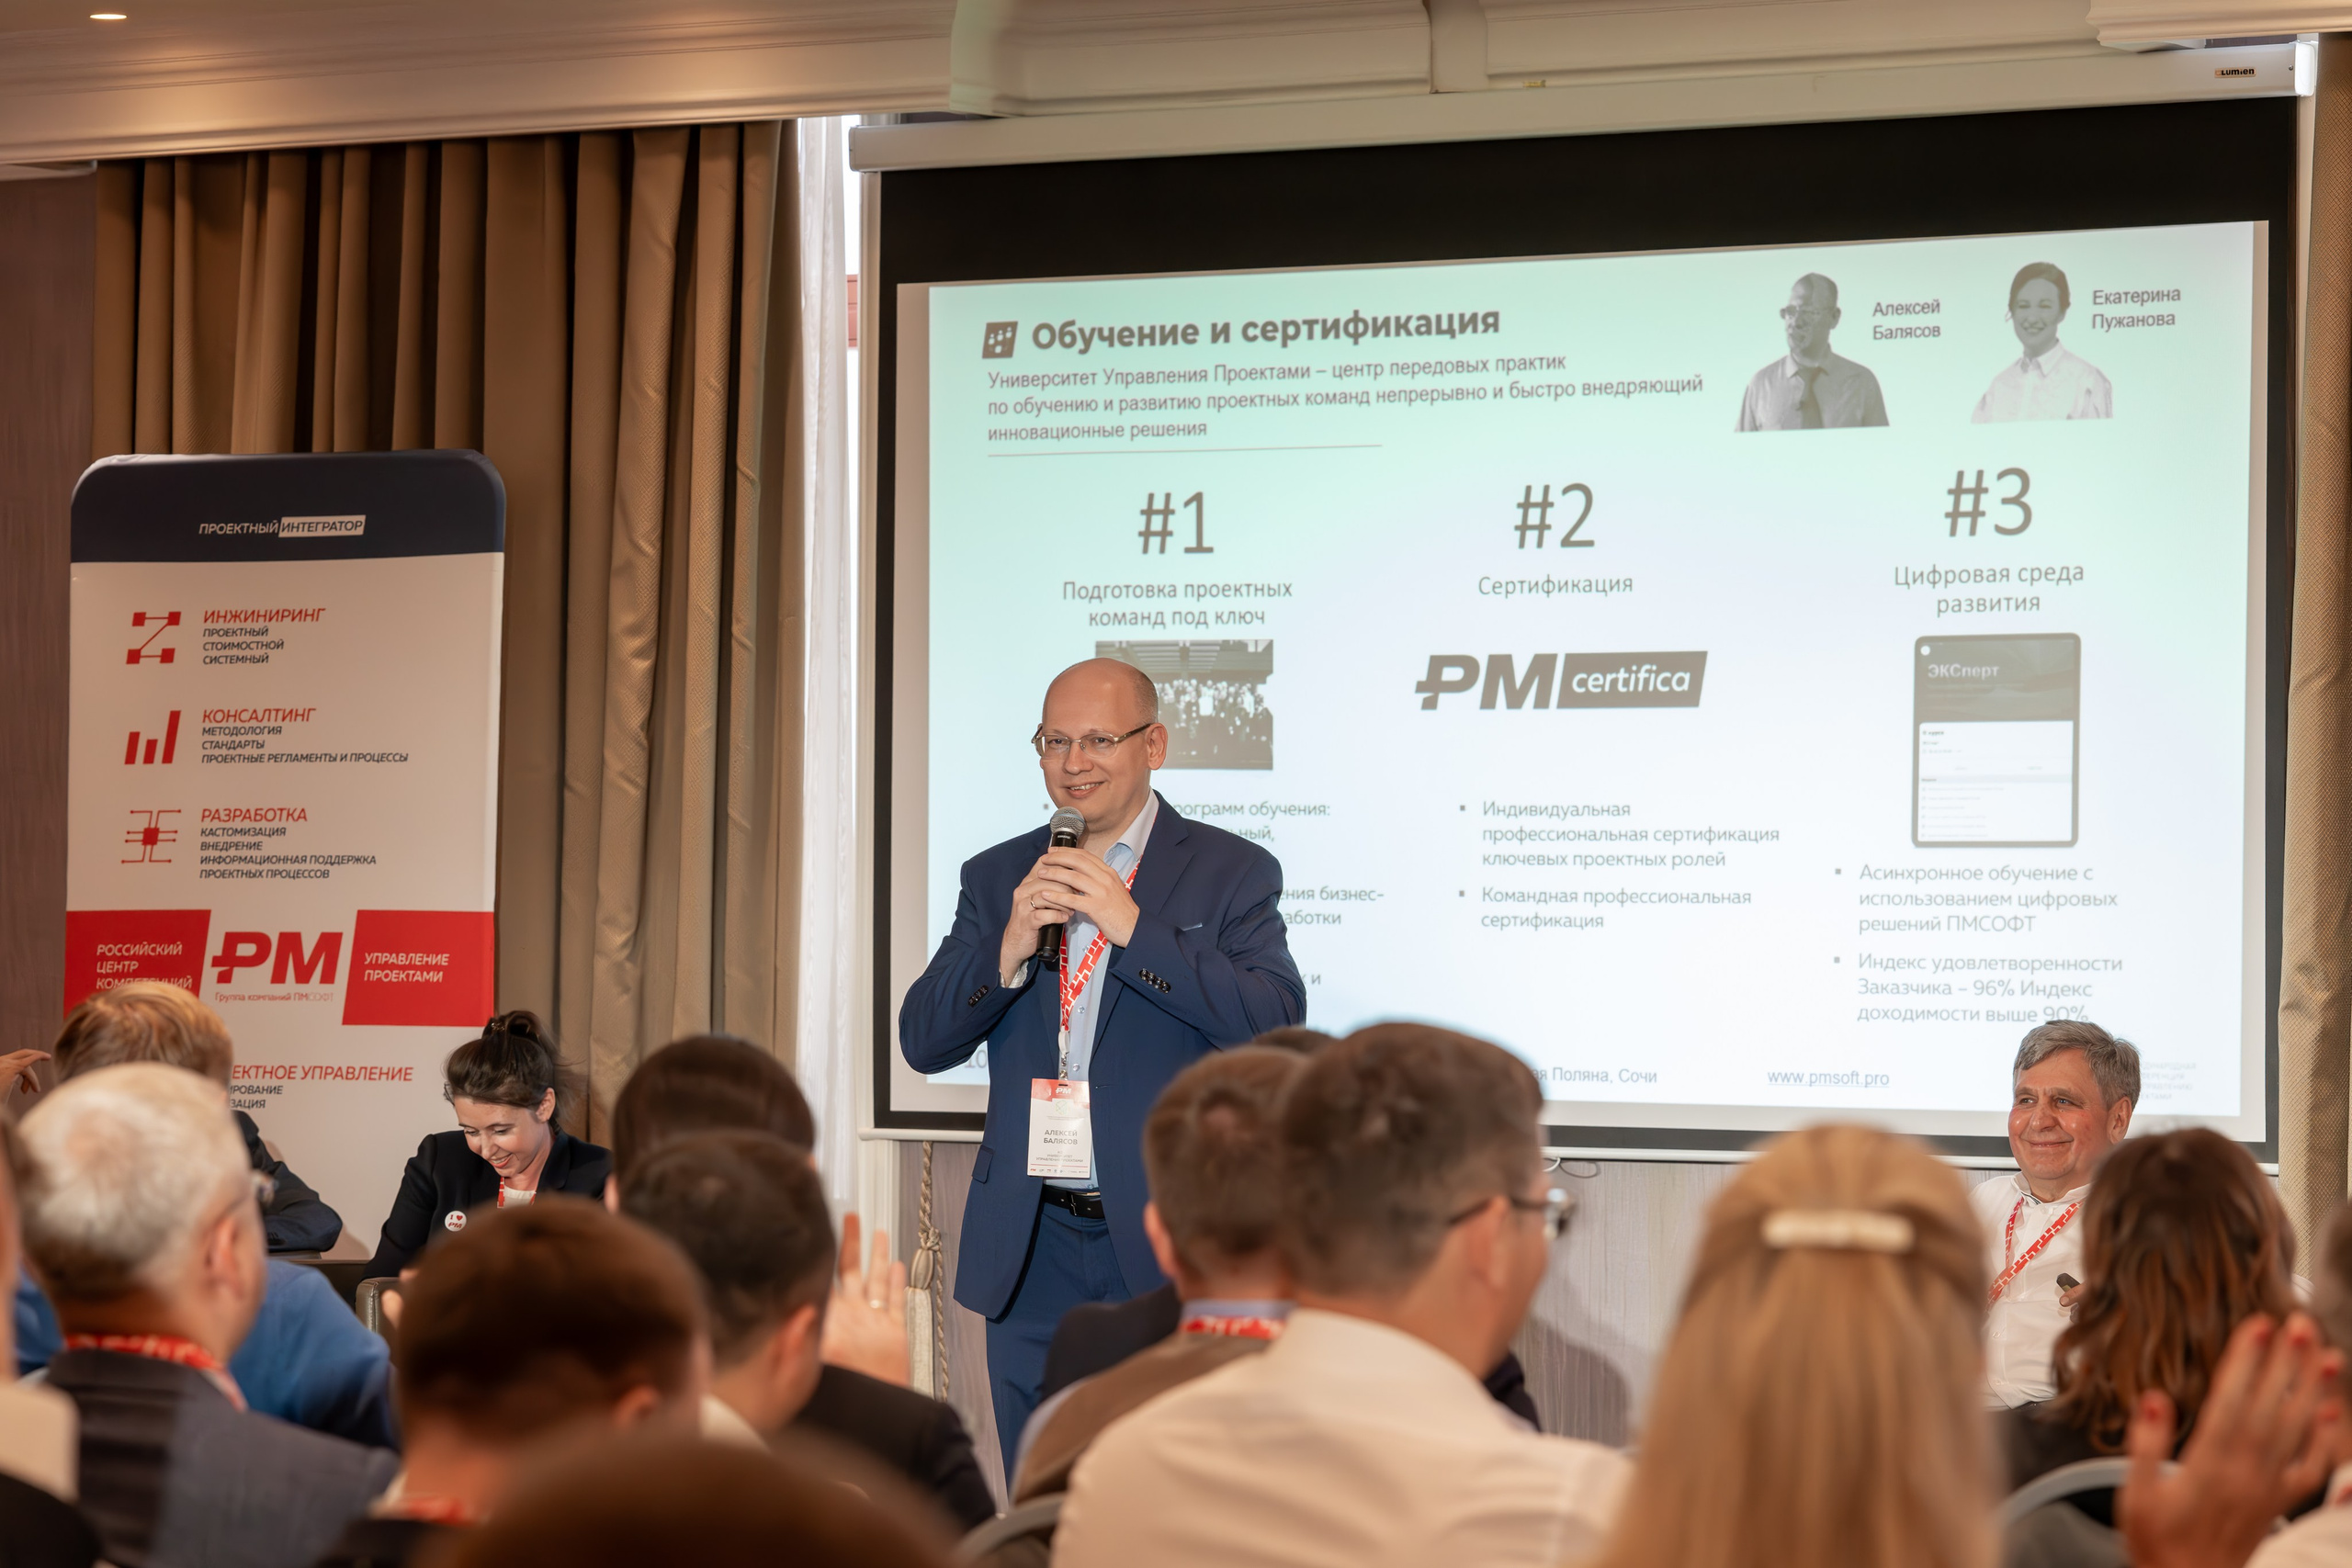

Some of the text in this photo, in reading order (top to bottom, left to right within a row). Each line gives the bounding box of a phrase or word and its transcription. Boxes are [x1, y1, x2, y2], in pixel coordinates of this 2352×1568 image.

[2092, 286, 2181, 307] Екатерина
[1872, 299, 1940, 318] Алексей
[2091, 310, 2176, 333] Пужанова
[1032, 310, 1499, 355] Обучение и сертификация
[1872, 321, 1941, 342] Балясов
[988, 369, 1098, 391] Университет
[1102, 367, 1208, 389] Управления
[1215, 364, 1311, 386] Проектами
[1332, 359, 1385, 379] центр
[1389, 357, 1489, 378] передовых
[1496, 355, 1566, 375] практик
[988, 374, 1703, 418] по обучению и развитию проектных команд непрерывно и быстро внедряющий
[988, 421, 1207, 443] инновационные решения
[1943, 467, 2032, 537] #3
[1137, 491, 1215, 555] #1
[1513, 482, 1596, 551] #2
[198, 520, 363, 535] ПРОЕКТНЫЙ ИНТЕГРАТОР
[1477, 573, 1634, 599] Сертификация
[1893, 563, 2085, 590] Цифровая среда
[1062, 581, 1293, 604] Подготовка проектных
[1936, 593, 2041, 618] развития
[202, 608, 326, 624] ИНЖИНИРИНГ
[1089, 610, 1265, 629] команд под ключ
[202, 626, 269, 637] ПРОЕКТНЫЙ
[202, 639, 285, 651] СТОИМОСТНОЙ
[202, 652, 270, 665] СИСТЕМНЫЙ
[1928, 663, 1999, 680] ЭКСперт
[1415, 653, 1691, 711] PM certifica
[202, 708, 317, 724] КОНСАЛТИНГ
[202, 726, 283, 737] МЕТОДОЛОГИЯ
[201, 739, 266, 751] СТАНДАРТЫ
[200, 752, 410, 764] ПРОЕКТНЫЕ РЕГЛАМЕНТЫ И ПРОЦЕССЫ
[200, 808, 309, 823] РАЗРАБОТКА
[1172, 801, 1330, 820] рограмм обучения:
[1483, 801, 1632, 820] Индивидуальная
[200, 827, 288, 840] КАСТОМИЗАЦИЯ
[1483, 826, 1780, 845] профессиональная сертификация
[200, 840, 263, 852] ВНЕДРЕНИЕ
[199, 854, 377, 867] ИНФОРМАЦИОННАЯ ПОДДЕРЖКА
[1482, 851, 1726, 871] ключевых проектных ролей
[198, 868, 331, 880] ПРОЕКТНЫХ ПРОЦЕССОВ
[1860, 863, 1984, 886] Асинхронное
[1988, 864, 2078, 886] обучение
[1319, 886, 1385, 901] бизнес-
[1482, 886, 1752, 908] Командная профессиональная
[1860, 891, 2119, 911] использованием цифровых
[1284, 909, 1341, 925] аботки
[1481, 912, 1604, 931] сертификация
[1859, 915, 2037, 935] решений ПМСОФТ
[96, 941, 184, 957] РОССИЙСКИЙ
[210, 931, 344, 985] PM
[96, 960, 140, 975] ЦЕНТР
[364, 953, 450, 966] УПРАВЛЕНИЕ
[1859, 953, 2123, 976] Индекс удовлетворенности
[364, 969, 445, 983] ПРОЕКТАМИ
[215, 992, 246, 1003] Группа
[248, 992, 292, 1001] компаний
[1858, 978, 1953, 996] Заказчика
[1973, 979, 2016, 998] 96%
[2020, 980, 2093, 999] Индекс
[1857, 1006, 1981, 1023] доходимости
[1985, 1007, 2038, 1022] выше
[232, 1065, 414, 1082] ЕКТНОЕ УПРАВЛЕНИЕ
[1553, 1067, 1613, 1084] Поляна,
[1619, 1068, 1657, 1083] Сочи
[1768, 1069, 1891, 1088] www.pmsoft.pro
[230, 1099, 266, 1110] ЗАЦИЯ
[1044, 1129, 1079, 1137] АЛЕКСЕЙ
[1044, 1137, 1079, 1145] БАЛЯСОВ
